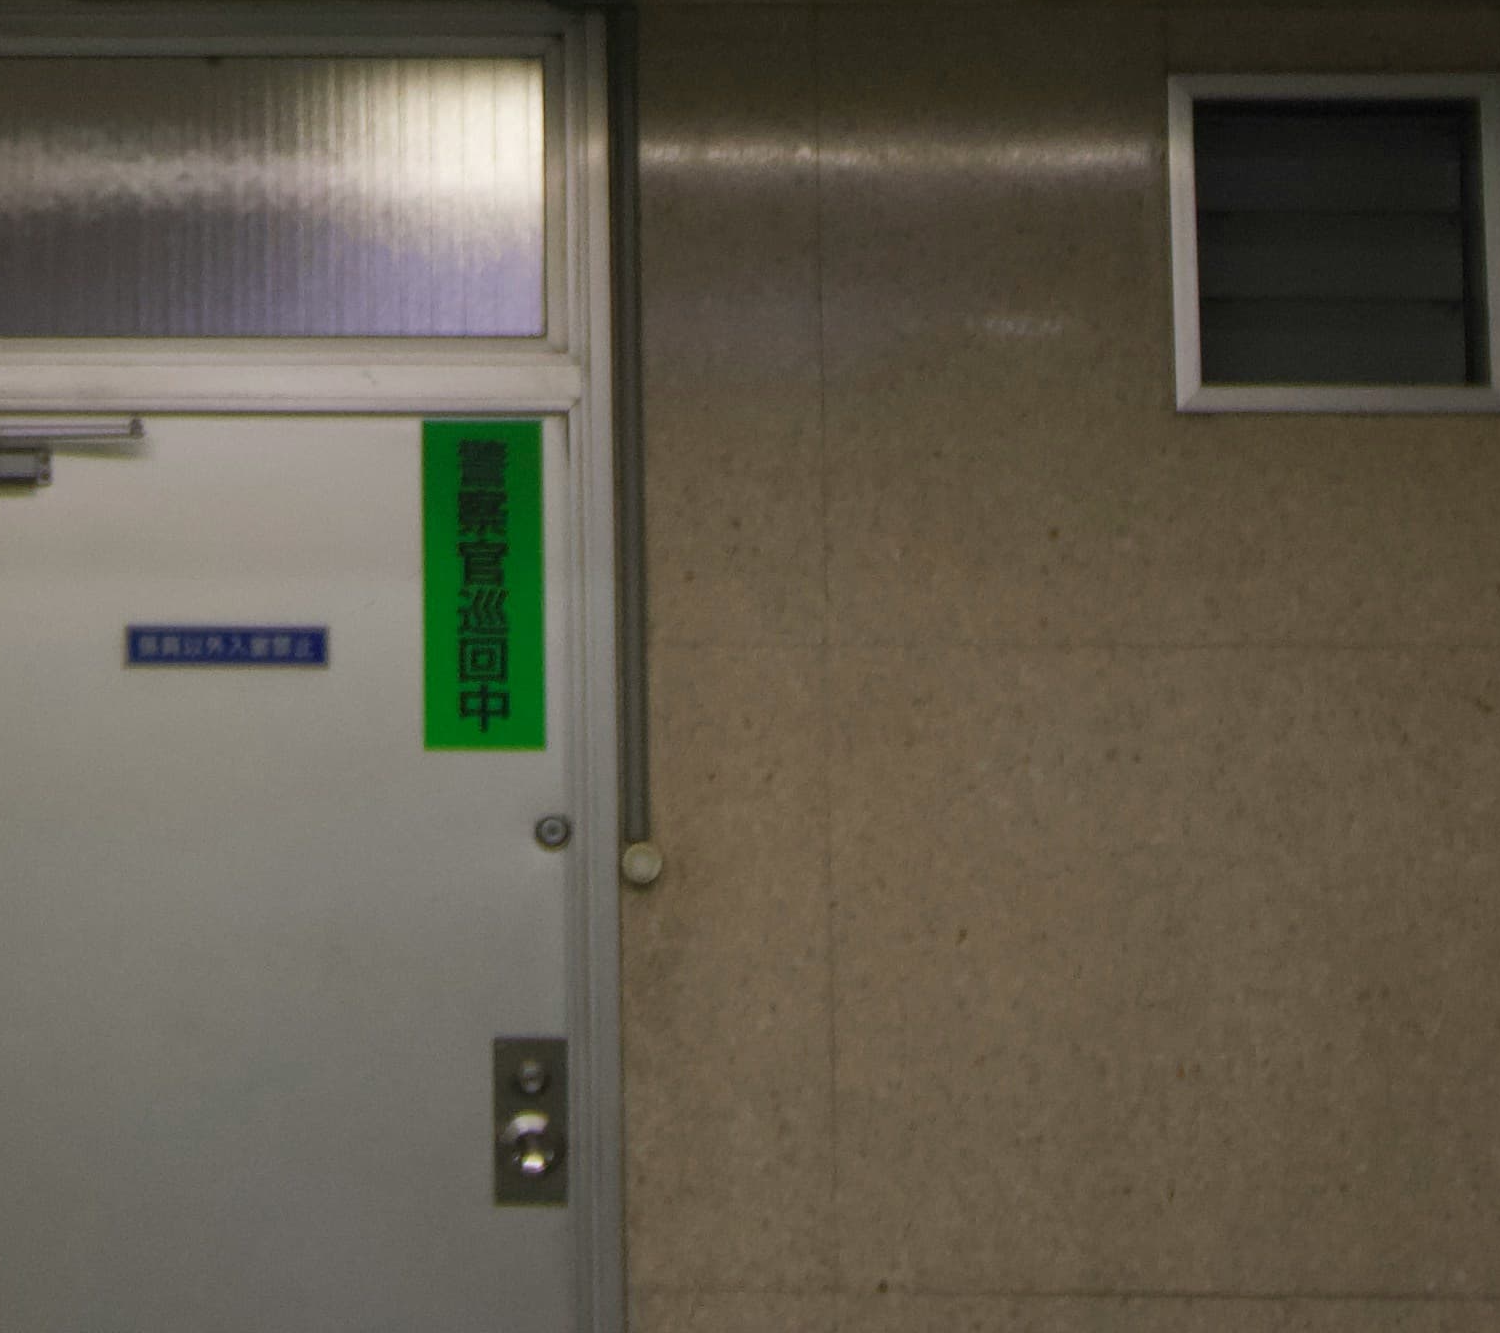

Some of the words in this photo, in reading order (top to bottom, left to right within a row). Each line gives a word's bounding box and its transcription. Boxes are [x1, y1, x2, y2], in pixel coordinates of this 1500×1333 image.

[457, 438, 509, 733] 警察官巡回中
